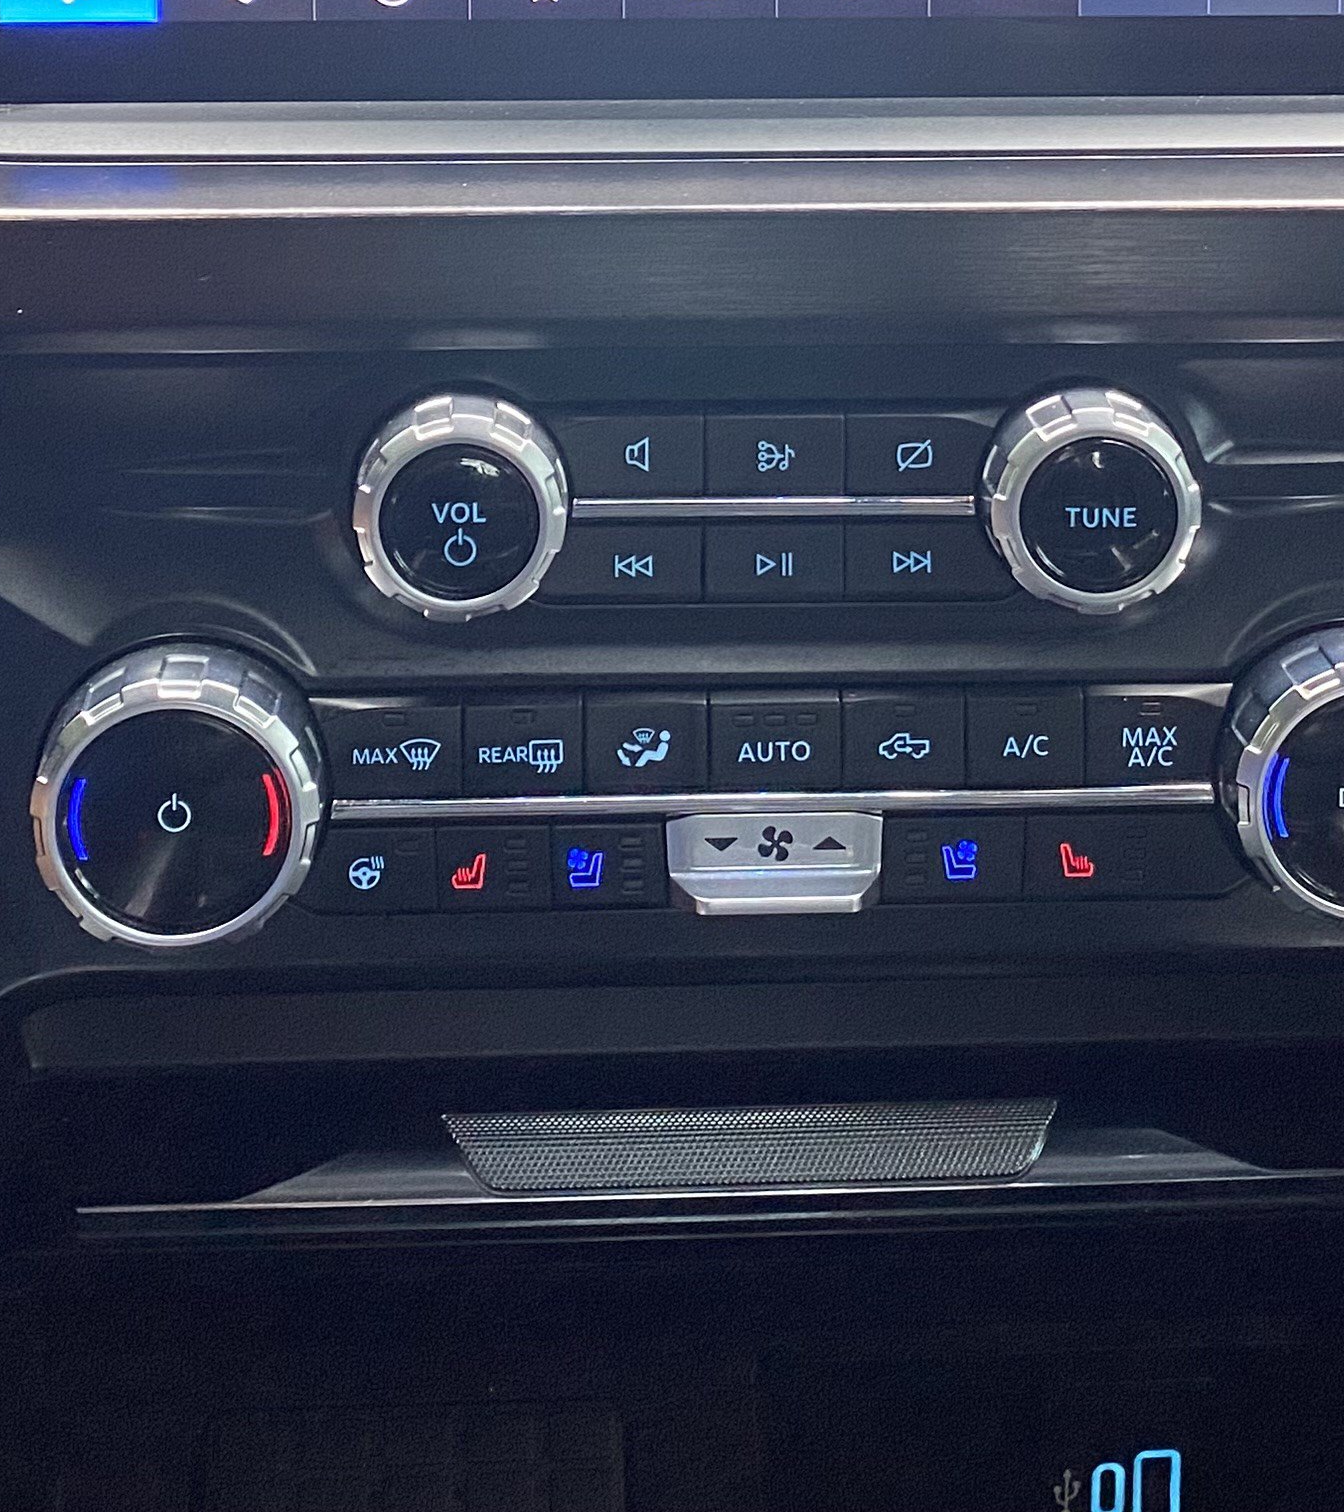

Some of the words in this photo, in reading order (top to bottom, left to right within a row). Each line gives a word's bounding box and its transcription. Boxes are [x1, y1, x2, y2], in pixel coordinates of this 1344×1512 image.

[431, 501, 487, 524] VOL
[1065, 506, 1137, 529] TUNE
[1003, 734, 1049, 758] A/C
[1122, 726, 1178, 748] MAX
[352, 747, 397, 766] MAX
[478, 746, 528, 765] REAR
[737, 740, 811, 763] AUTO
[1127, 745, 1174, 768] A/C
